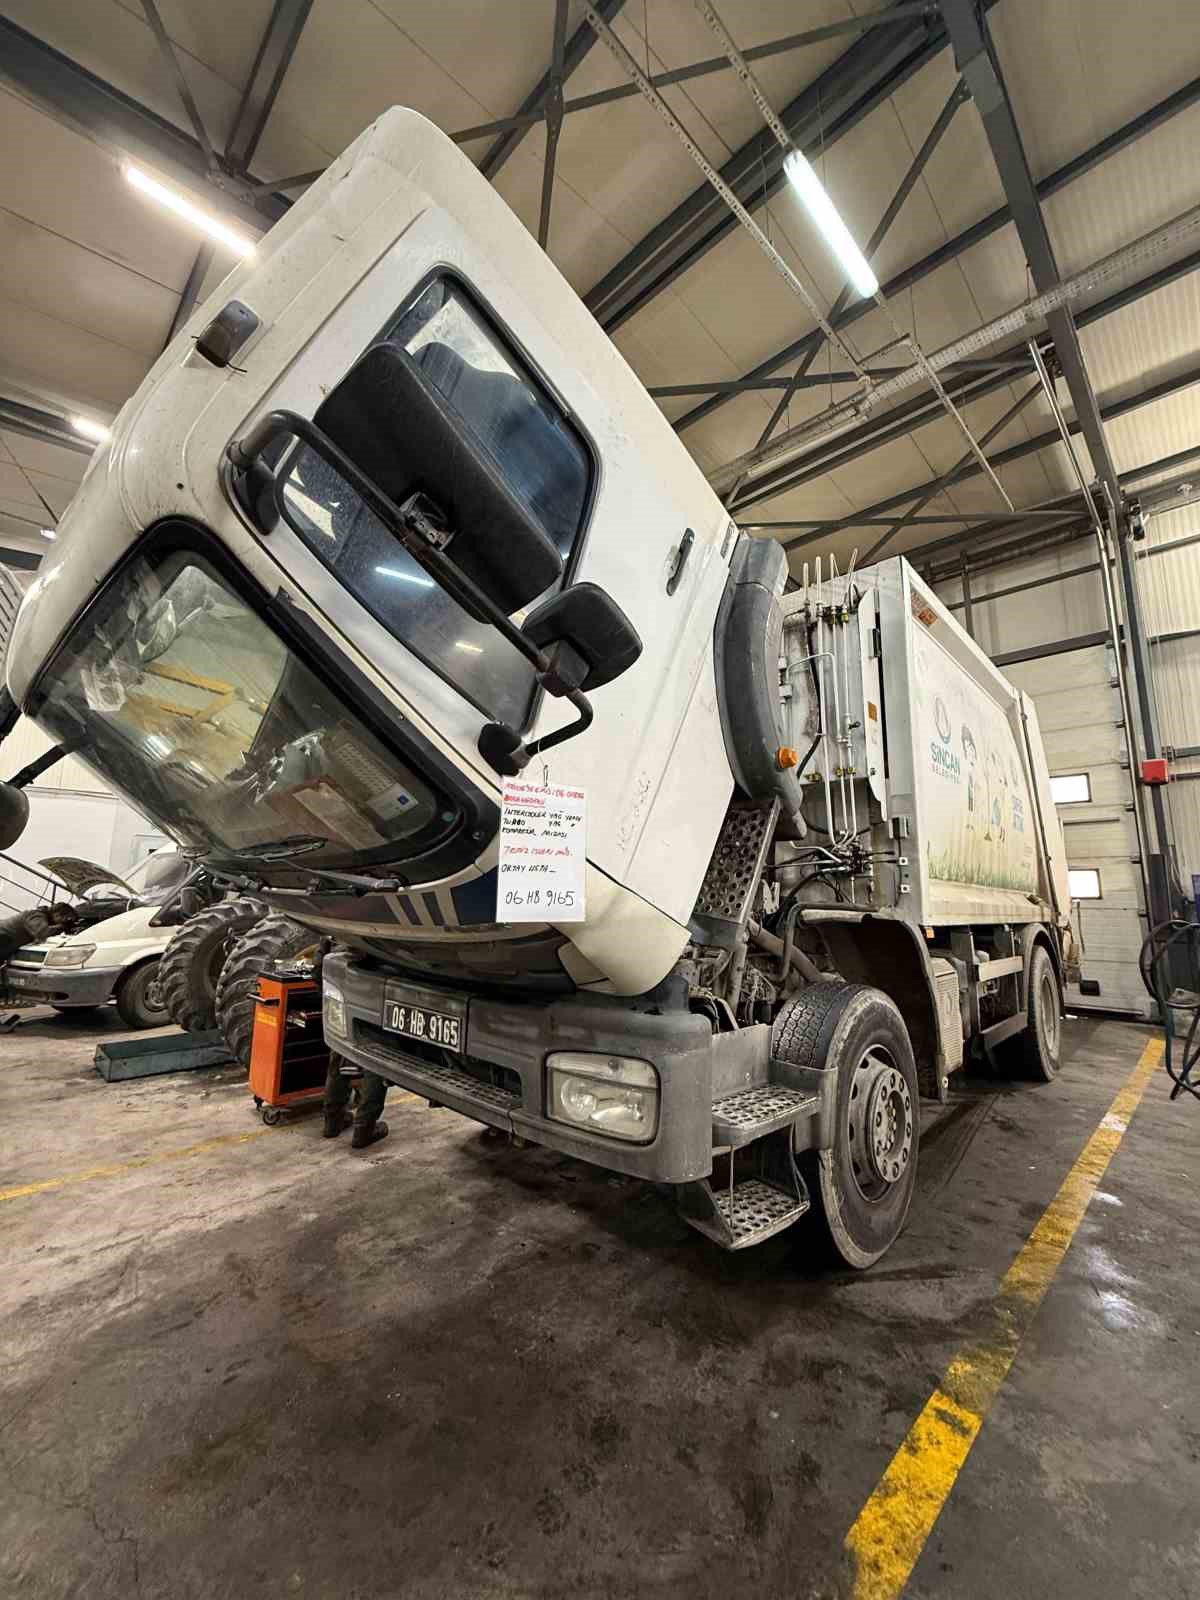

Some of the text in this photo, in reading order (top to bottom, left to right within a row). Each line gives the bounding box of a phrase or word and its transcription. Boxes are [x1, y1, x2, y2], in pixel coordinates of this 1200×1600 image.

[505, 890, 576, 907] 06 HB 9165
[392, 1006, 458, 1046] 06 HB 9165
